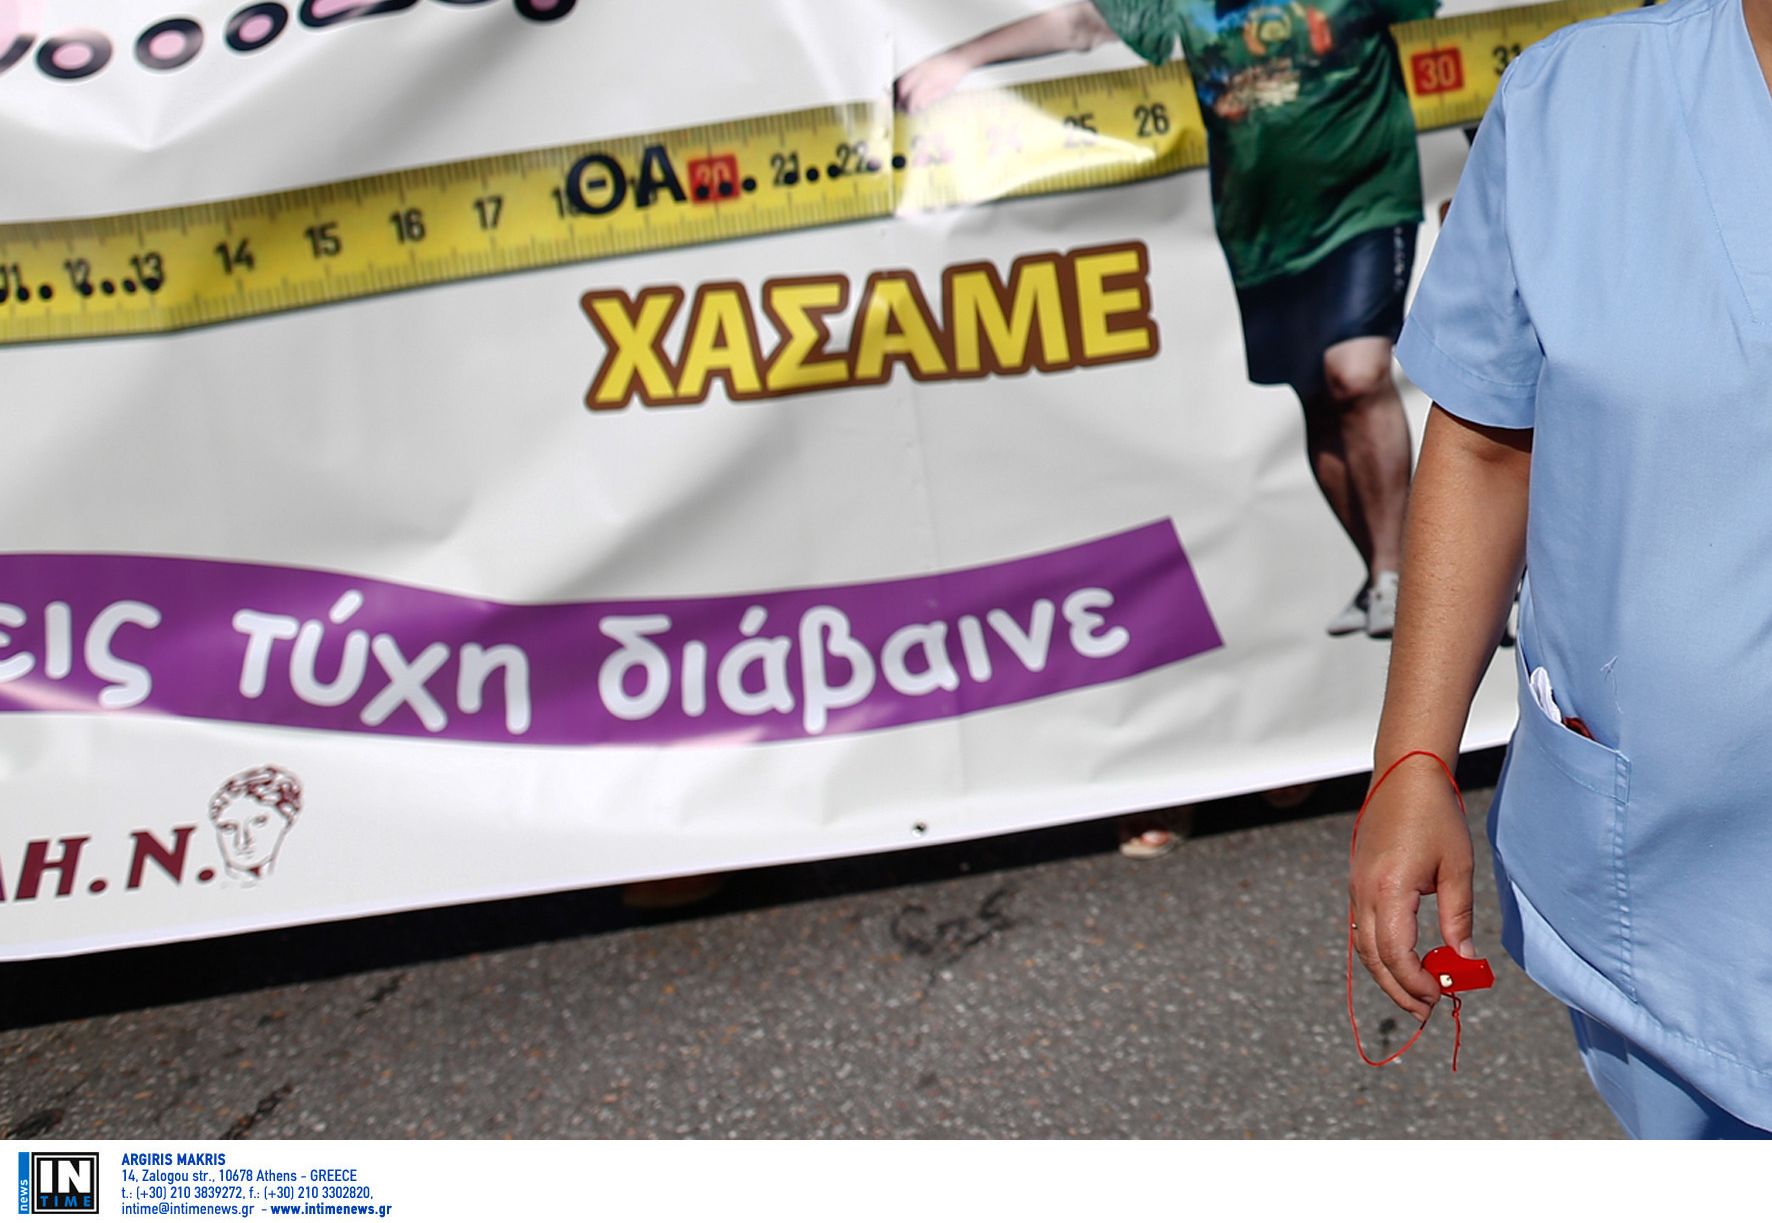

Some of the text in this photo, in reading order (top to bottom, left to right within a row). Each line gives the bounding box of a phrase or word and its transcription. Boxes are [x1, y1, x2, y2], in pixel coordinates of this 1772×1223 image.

[214, 238, 255, 274] 14
[304, 222, 342, 260] 15
[389, 207, 426, 244] 16
[473, 193, 504, 232] 17
[1134, 102, 1169, 138] 26
[1419, 53, 1456, 89] 30
[581, 241, 1160, 411] ΧΑΣΑΜΕ
[232, 590, 531, 734] τύχη
[600, 587, 1130, 735] διάβαινε
[0, 826, 217, 902] Η.Ν.
